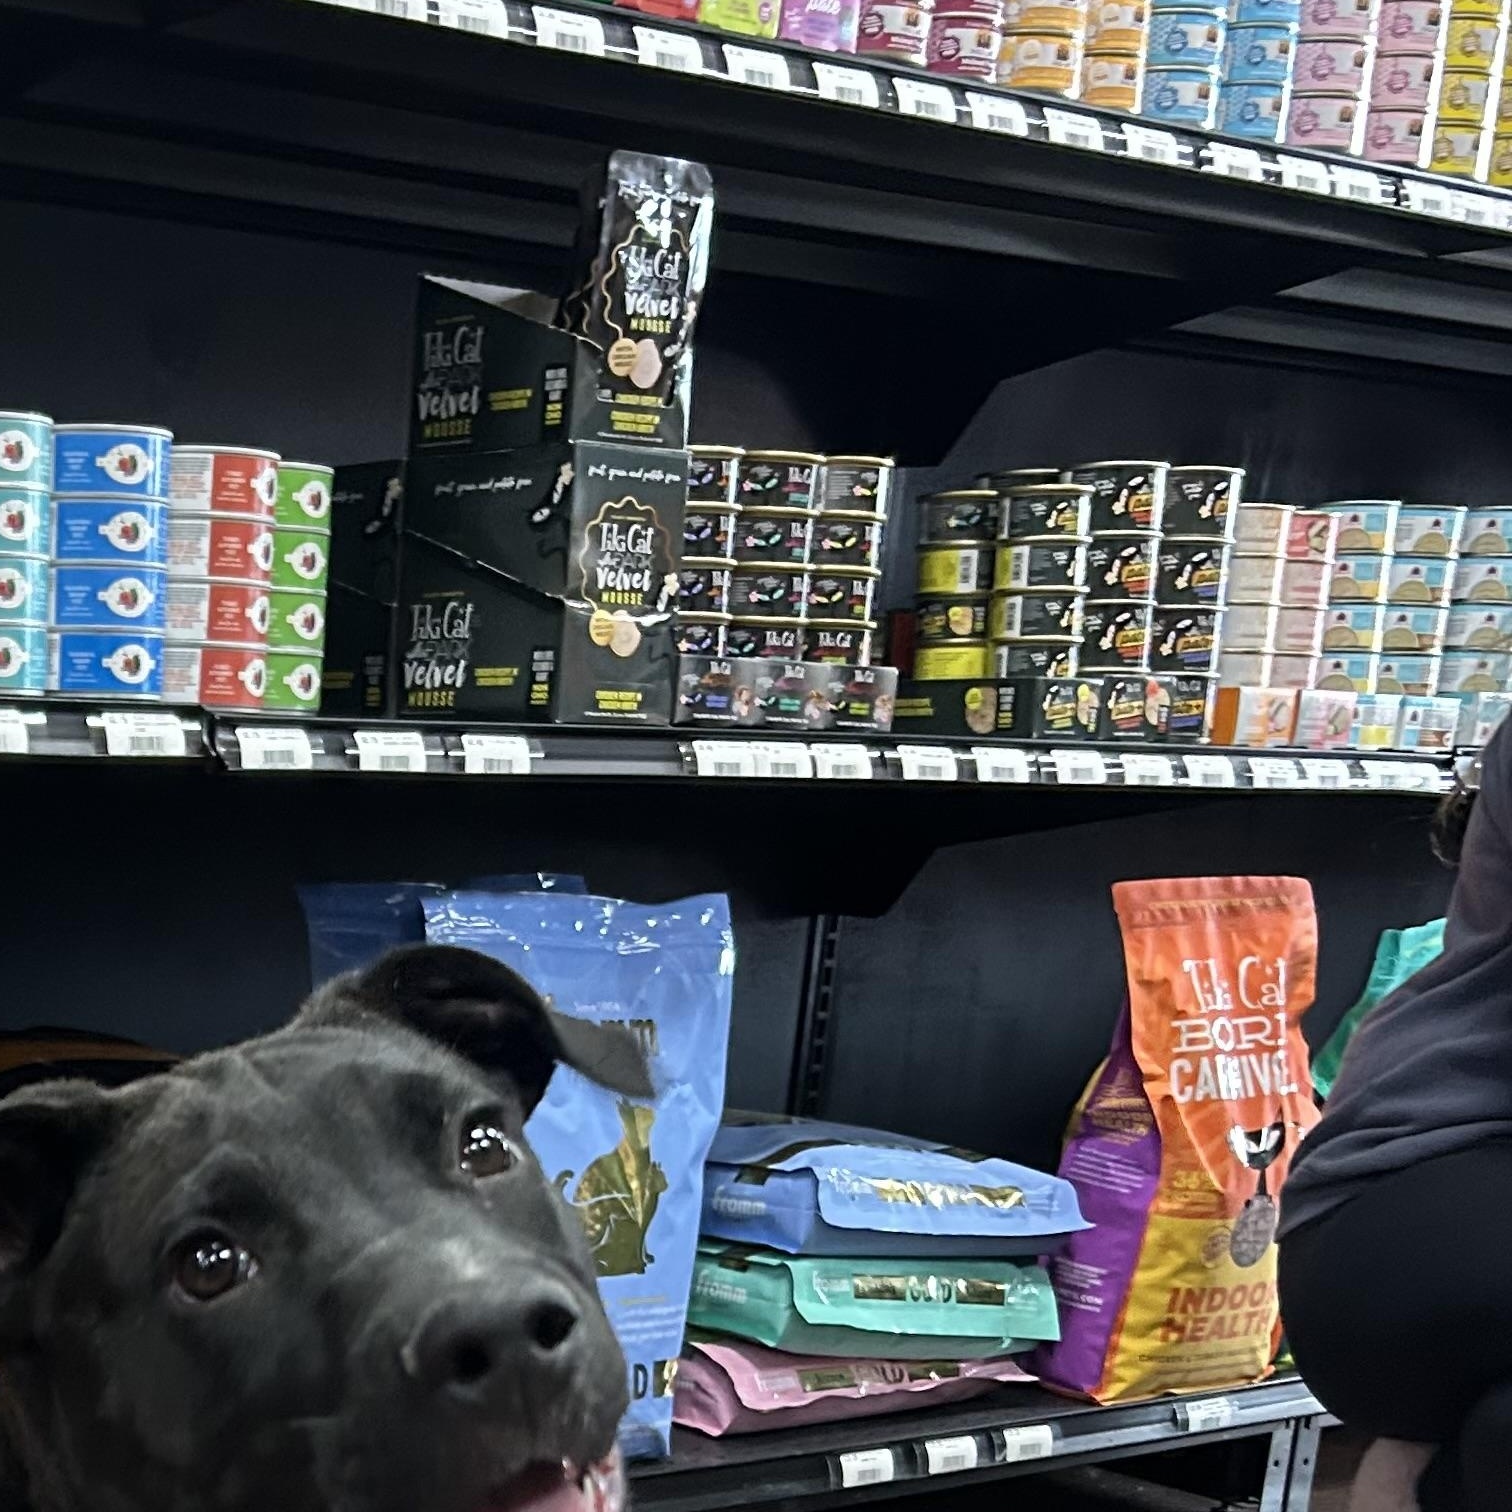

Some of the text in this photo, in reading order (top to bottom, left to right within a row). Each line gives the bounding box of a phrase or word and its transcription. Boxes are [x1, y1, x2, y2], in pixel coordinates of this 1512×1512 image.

[628, 523, 655, 555] Cat
[443, 602, 474, 639] Cat
[1181, 955, 1287, 1014] Tiki Cat
[710, 1184, 768, 1217] fromm
[695, 1269, 749, 1304] fromm
